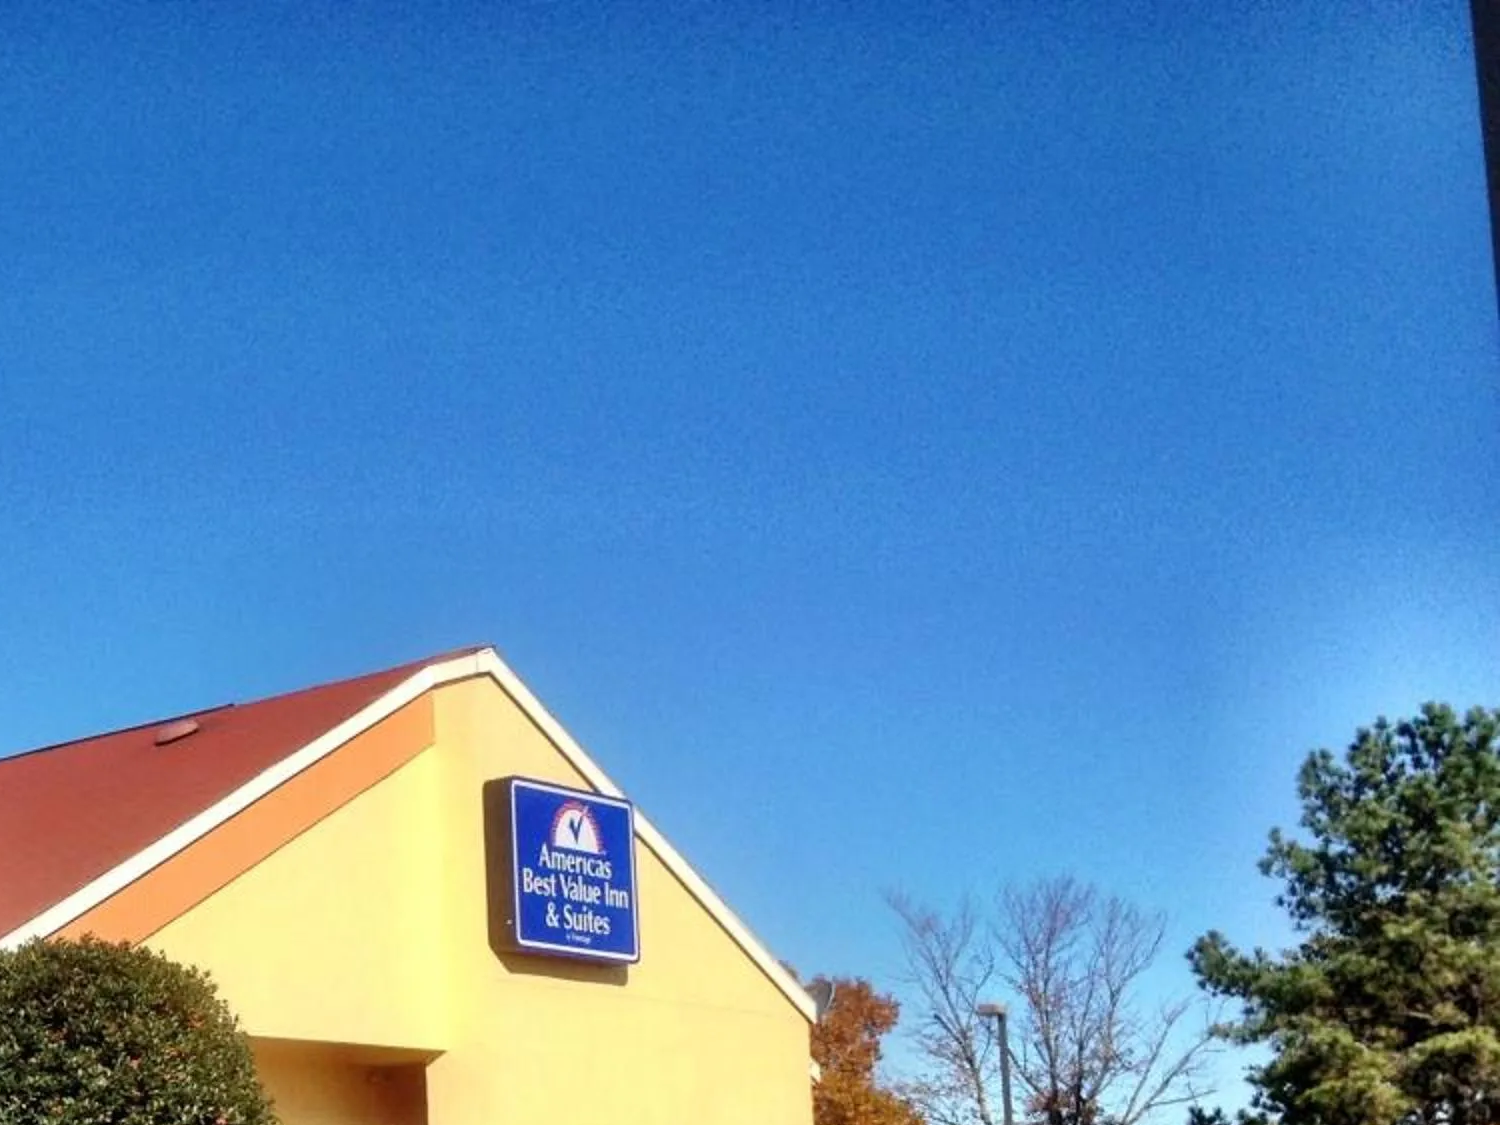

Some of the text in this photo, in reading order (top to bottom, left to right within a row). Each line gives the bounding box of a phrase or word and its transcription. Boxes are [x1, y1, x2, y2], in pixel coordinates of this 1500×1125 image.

[538, 843, 613, 879] Americas
[522, 868, 629, 909] Best Value Inn
[545, 902, 611, 935] & Suites
